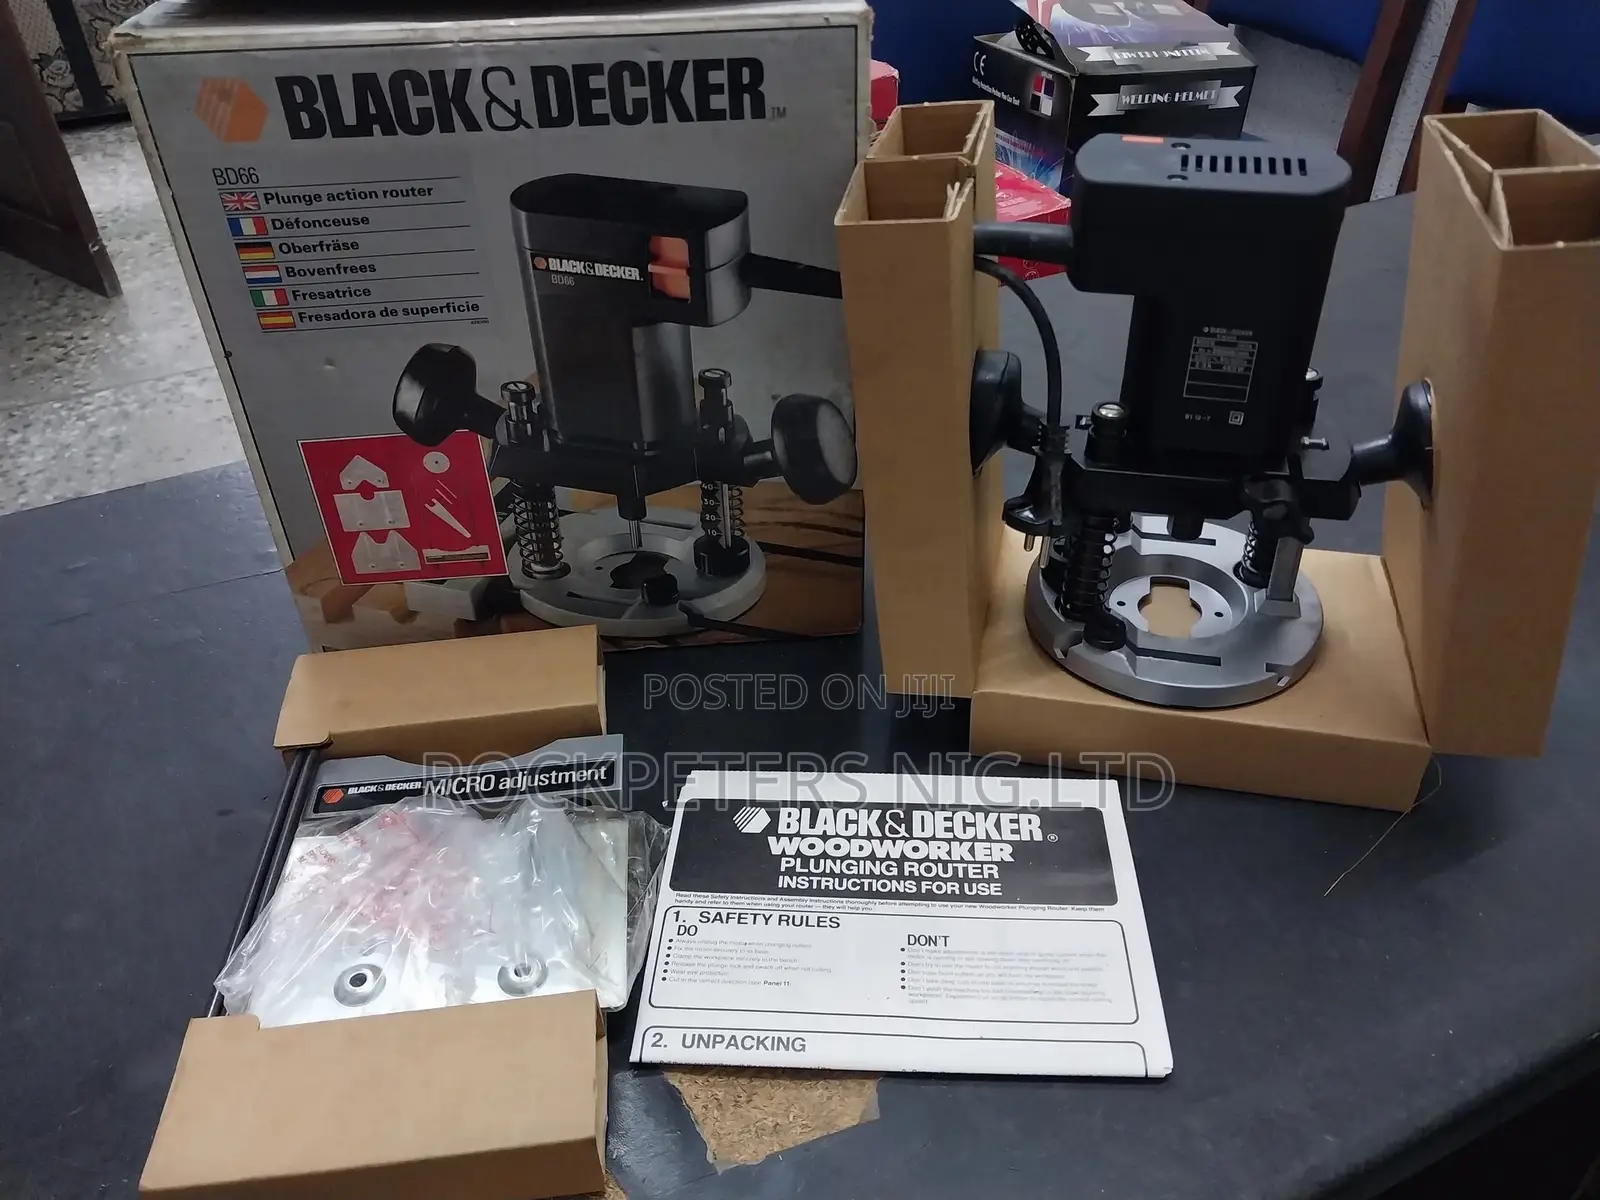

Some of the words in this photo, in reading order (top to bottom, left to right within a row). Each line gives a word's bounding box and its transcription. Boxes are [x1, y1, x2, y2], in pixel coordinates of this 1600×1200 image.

[275, 57, 767, 140] BLACK&DECKER
[1121, 92, 1172, 105] WELDING
[1174, 89, 1216, 102] HELMET
[212, 167, 260, 186] BD66
[263, 192, 322, 207] Plunge
[326, 188, 379, 202] action
[382, 185, 433, 200] router
[270, 214, 370, 231] Défonceuse
[278, 239, 359, 255] Oberfräse
[285, 262, 377, 279] Bovenfrees
[551, 273, 575, 287] BD66
[292, 286, 372, 302] Fresatrice
[297, 309, 376, 325] Fresadora
[379, 307, 398, 319] de
[401, 300, 480, 318] superficie
[701, 483, 714, 491] 40
[703, 498, 715, 506] 30
[705, 513, 716, 521] 20
[707, 528, 717, 537] 10
[425, 774, 495, 798] MICRO
[498, 765, 608, 792] adjustment
[777, 807, 1044, 842] BLACK&DECKER
[768, 836, 1014, 862] WOODWORKER
[780, 857, 898, 876] PLUNGING
[904, 861, 999, 879] ROUTER
[778, 875, 918, 894] INSTRUCTIONS
[921, 881, 960, 895] FOR
[964, 881, 1003, 897] USE
[779, 895, 808, 903] Assembly
[899, 899, 930, 907] attempting
[1071, 905, 1087, 913] Keep
[673, 910, 687, 923] 1.
[698, 910, 774, 926] SAFETY
[777, 914, 841, 929] RULES
[676, 924, 698, 937] DO
[907, 934, 950, 947] DON'T
[650, 1032, 667, 1048] 2.
[681, 1033, 807, 1053] UNPACKING
